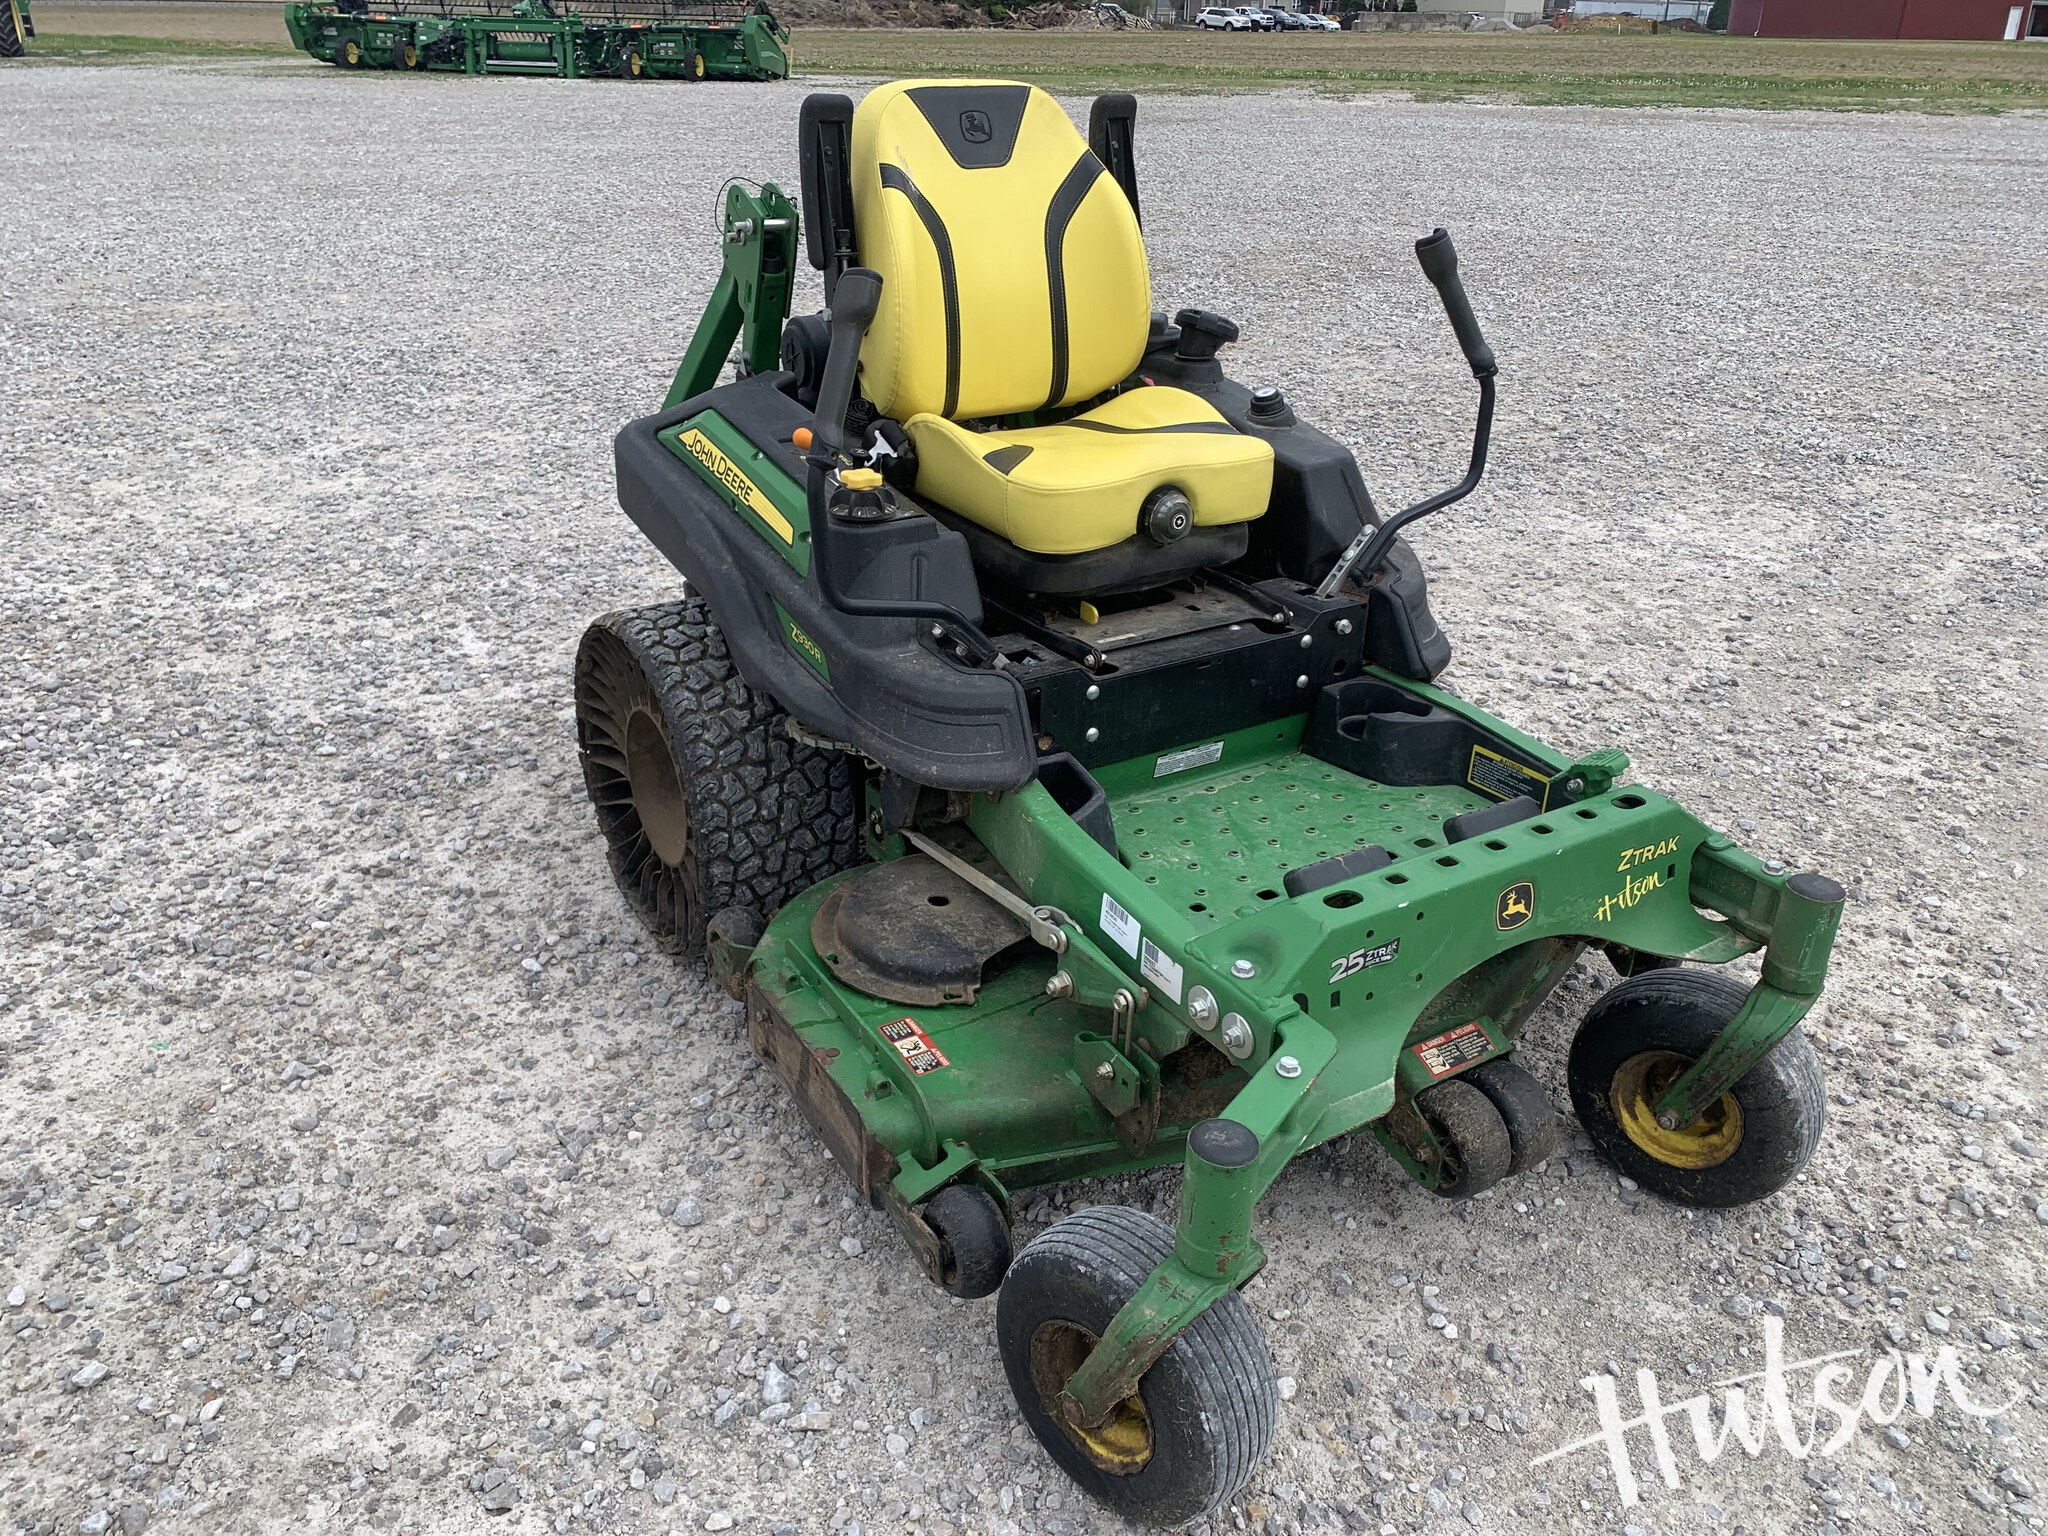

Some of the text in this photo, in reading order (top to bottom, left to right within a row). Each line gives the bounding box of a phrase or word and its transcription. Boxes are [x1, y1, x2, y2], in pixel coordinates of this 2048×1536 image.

[688, 432, 753, 503] JOHN DEERE
[790, 622, 822, 664] Z930R
[1617, 834, 1680, 872] ZTRAK
[1328, 947, 1365, 984] 25
[1365, 940, 1398, 962] ZTRAK
